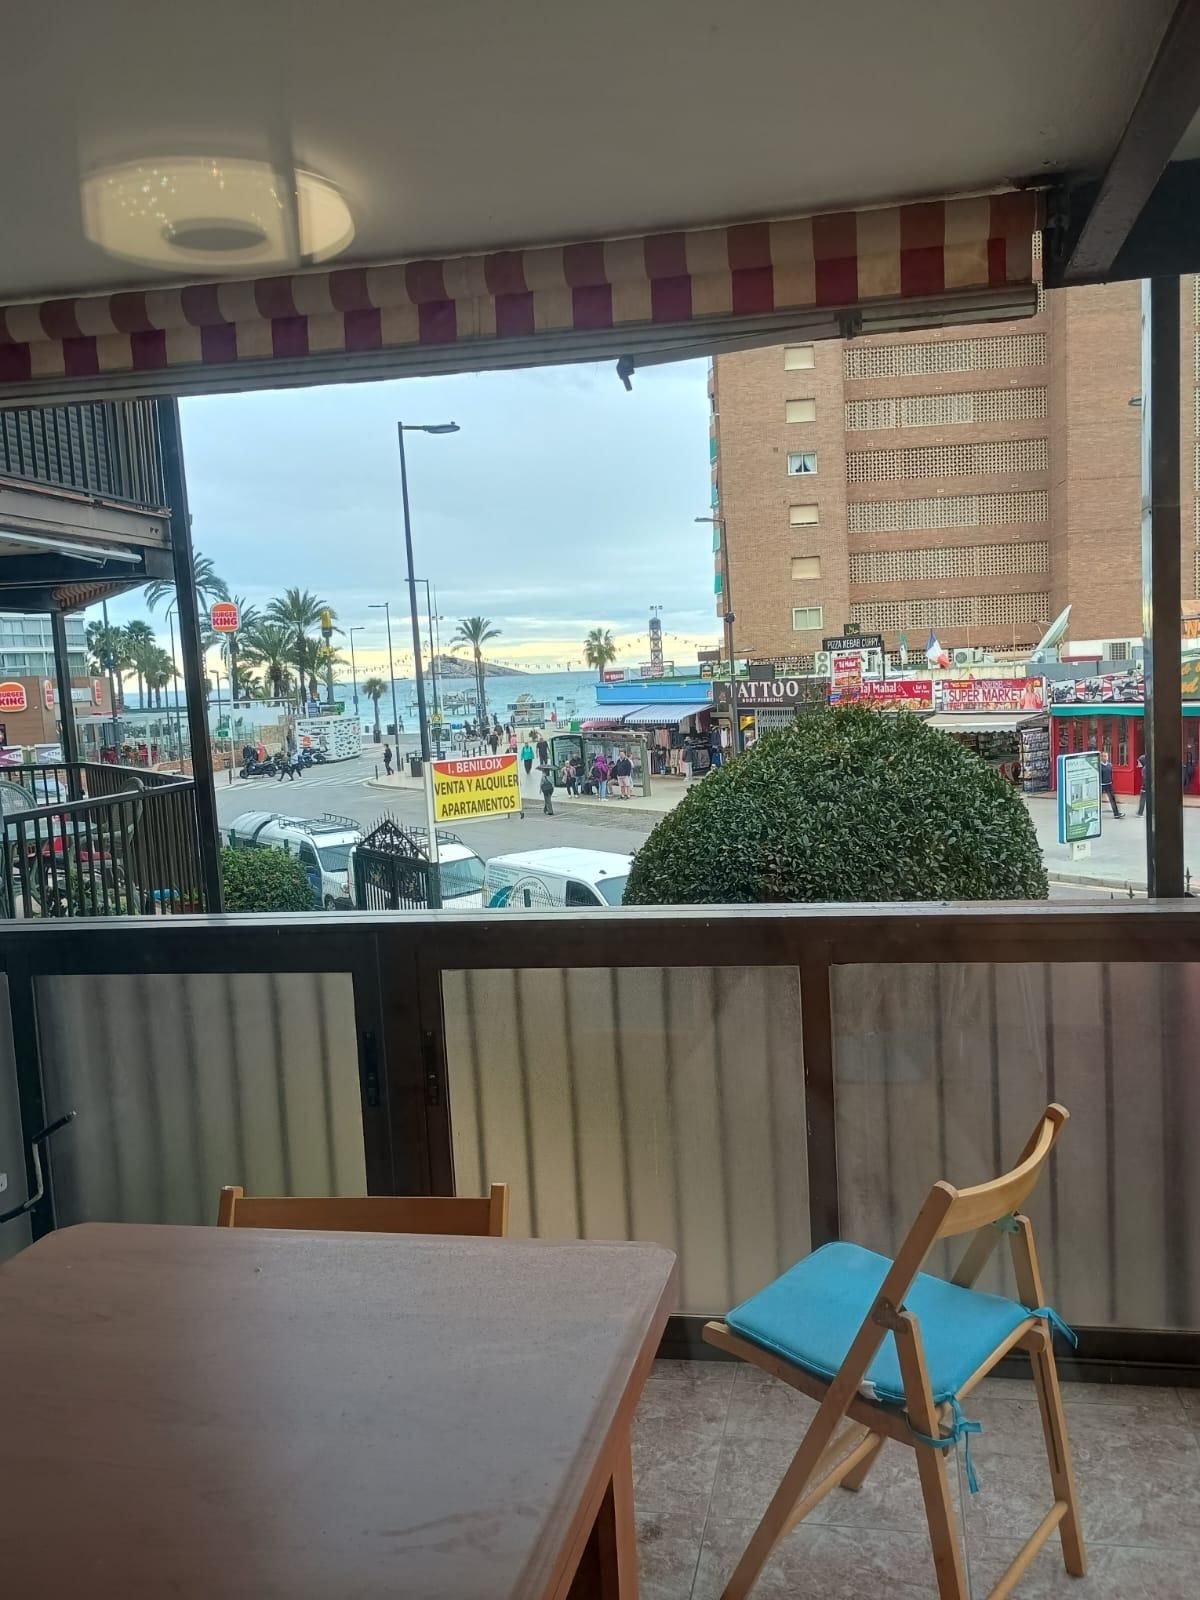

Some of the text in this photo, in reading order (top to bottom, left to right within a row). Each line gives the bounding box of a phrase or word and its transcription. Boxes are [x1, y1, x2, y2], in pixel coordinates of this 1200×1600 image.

[212, 617, 237, 625] KING
[827, 641, 841, 649] PIZZA
[872, 682, 897, 693] Mahal
[949, 688, 1024, 702] SUPER MARKET
[456, 758, 503, 773] BENILOIX
[434, 774, 520, 796] VENTA Y ALQUILER
[441, 795, 516, 817] APARTAMENTOS
